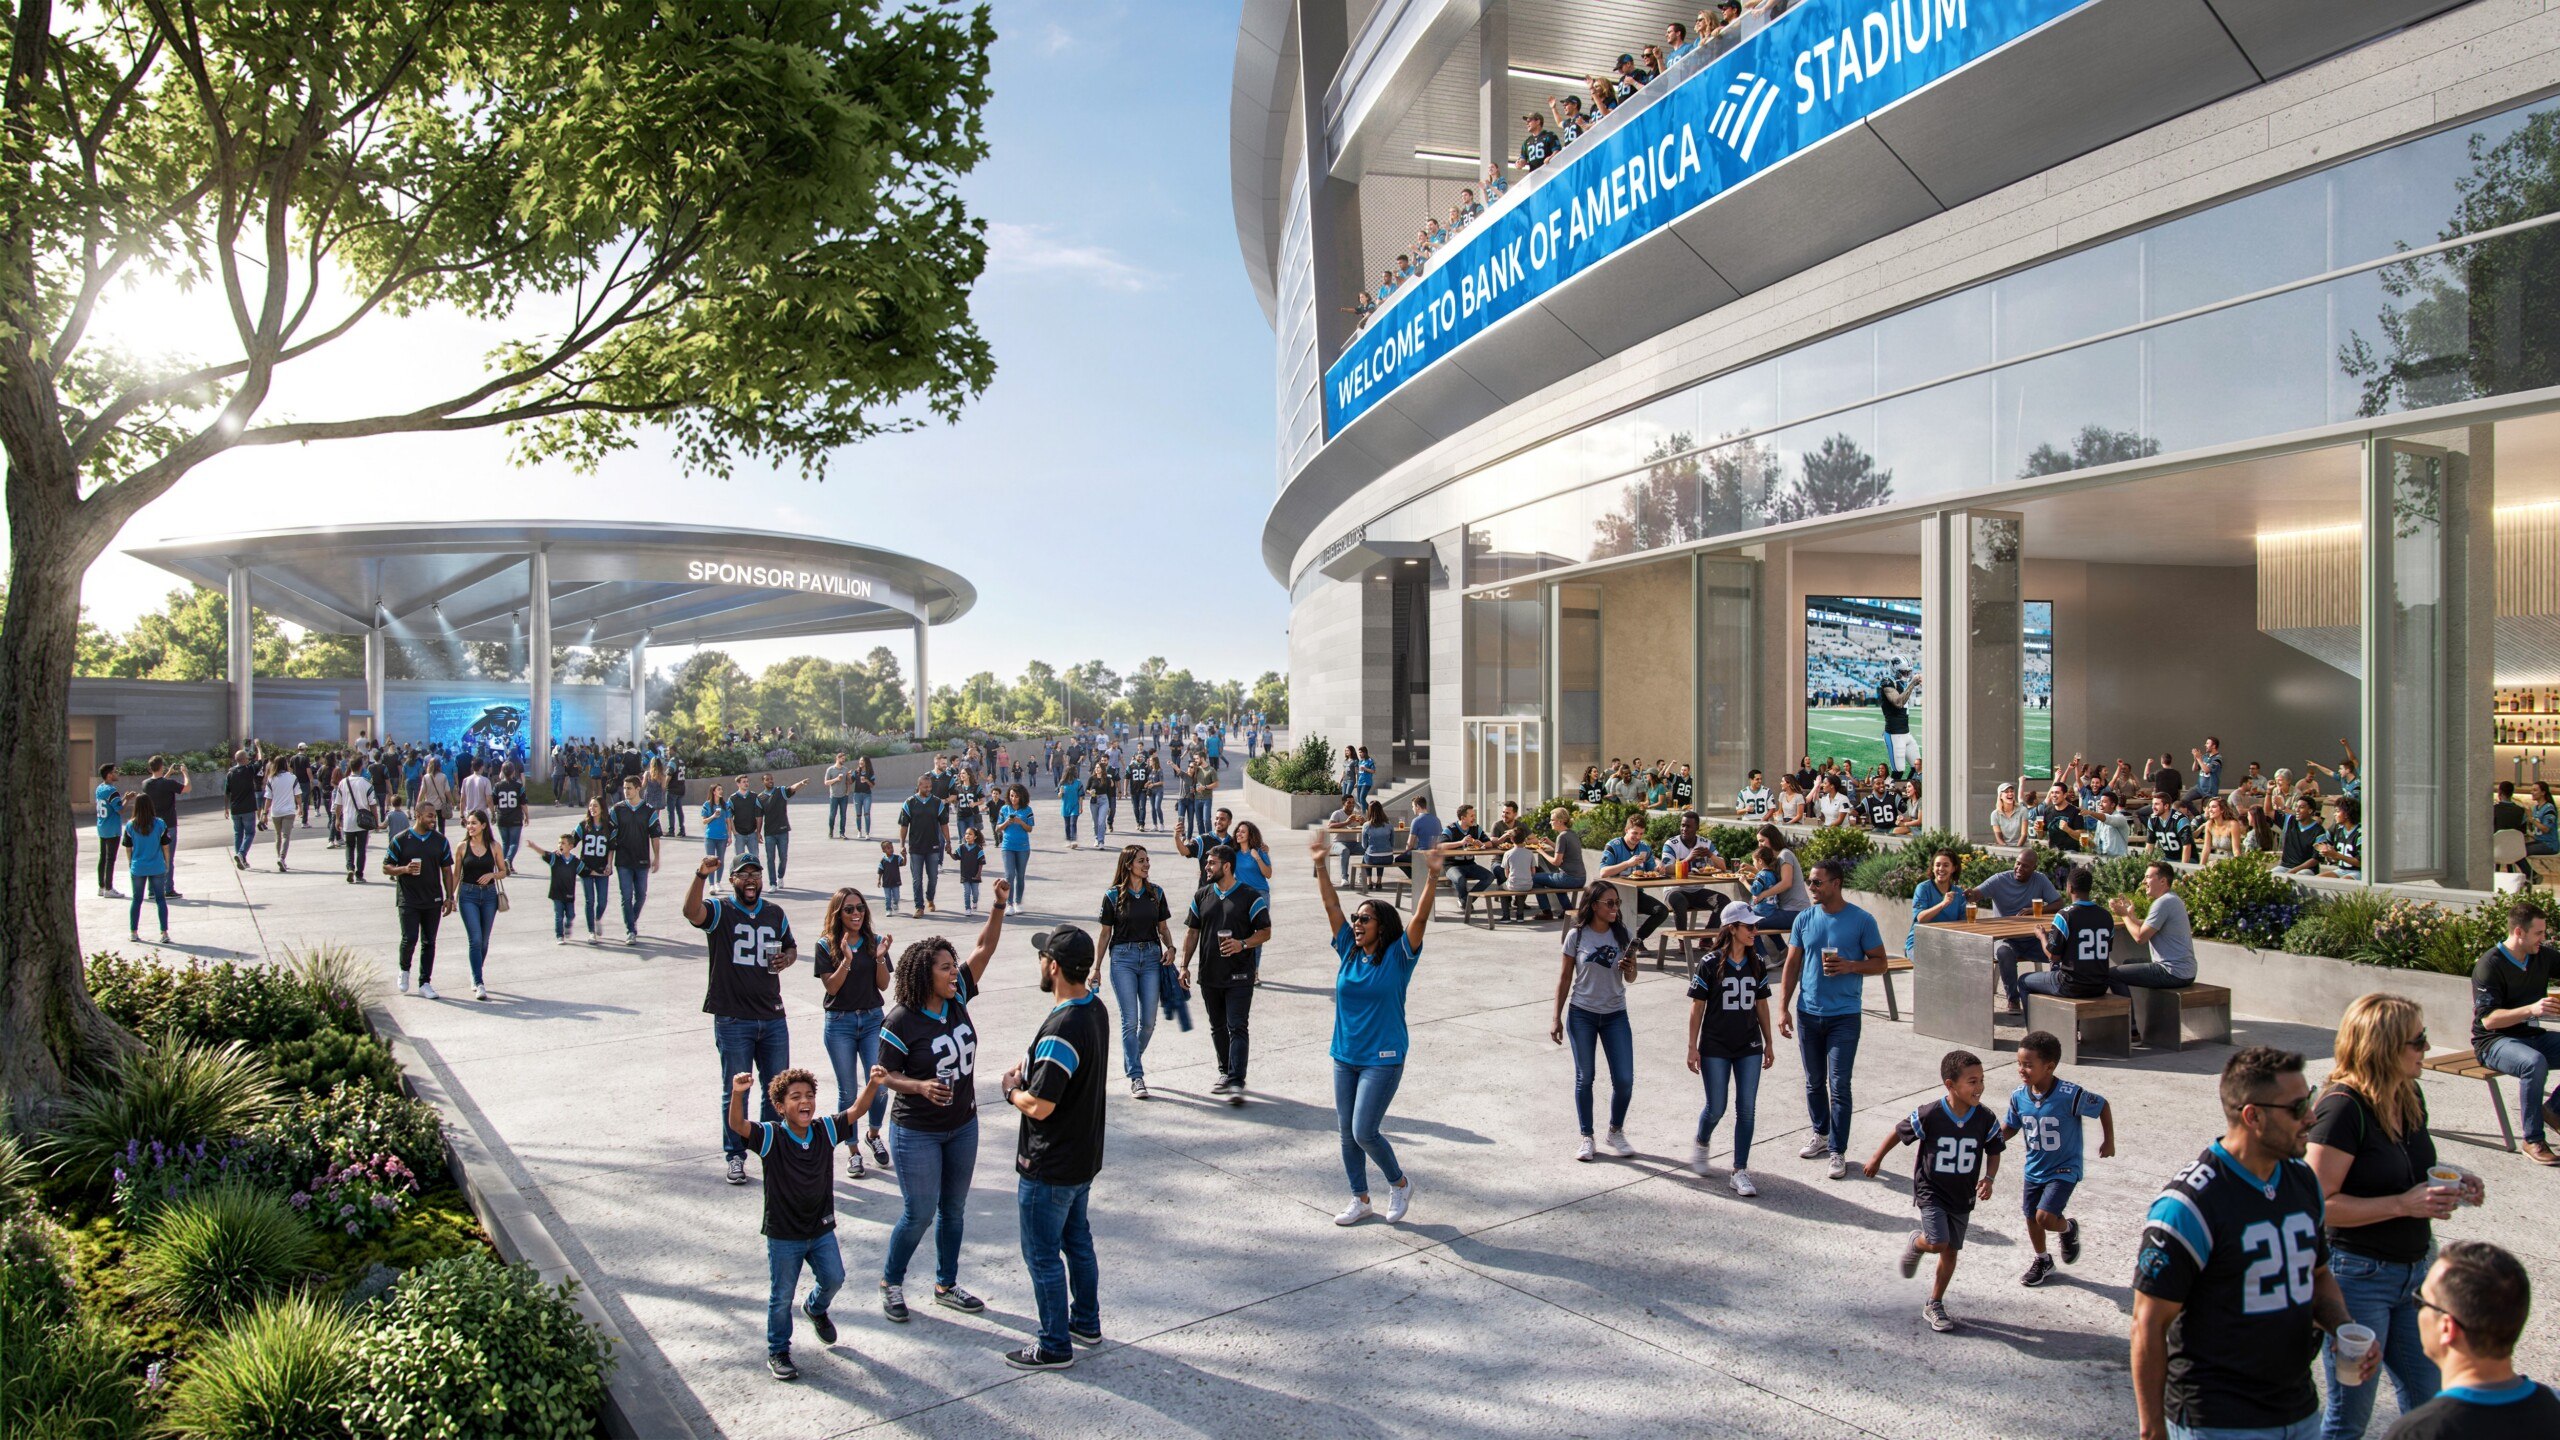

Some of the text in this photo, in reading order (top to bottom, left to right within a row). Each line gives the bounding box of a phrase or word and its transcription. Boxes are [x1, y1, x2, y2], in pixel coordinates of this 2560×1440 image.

[1563, 124, 1577, 142] 26
[1527, 142, 1545, 161] 26
[1463, 211, 1475, 226] 26
[1338, 311, 1425, 409] WELCOME
[1428, 289, 1456, 340] TO
[1461, 235, 1525, 319] BANK
[1529, 207, 1562, 270] OF
[1568, 122, 1701, 250] AMERICA
[688, 560, 872, 598] SPONSOR PAVILION
[1132, 769, 1146, 780] 26
[498, 790, 517, 808] 26
[1587, 789, 1601, 802] 26
[1677, 783, 1691, 797] 26
[1872, 804, 1894, 823] 26
[584, 834, 607, 857] 26
[2156, 832, 2180, 852] 26
[733, 923, 776, 968] 26
[2078, 928, 2110, 960] 26
[1721, 976, 1756, 1010] 26
[931, 1023, 975, 1081] 26
[2022, 1115, 2061, 1152] 26
[1935, 1136, 1977, 1174] 26
[2173, 1160, 2216, 1191] 26
[2241, 1211, 2317, 1314] 26
